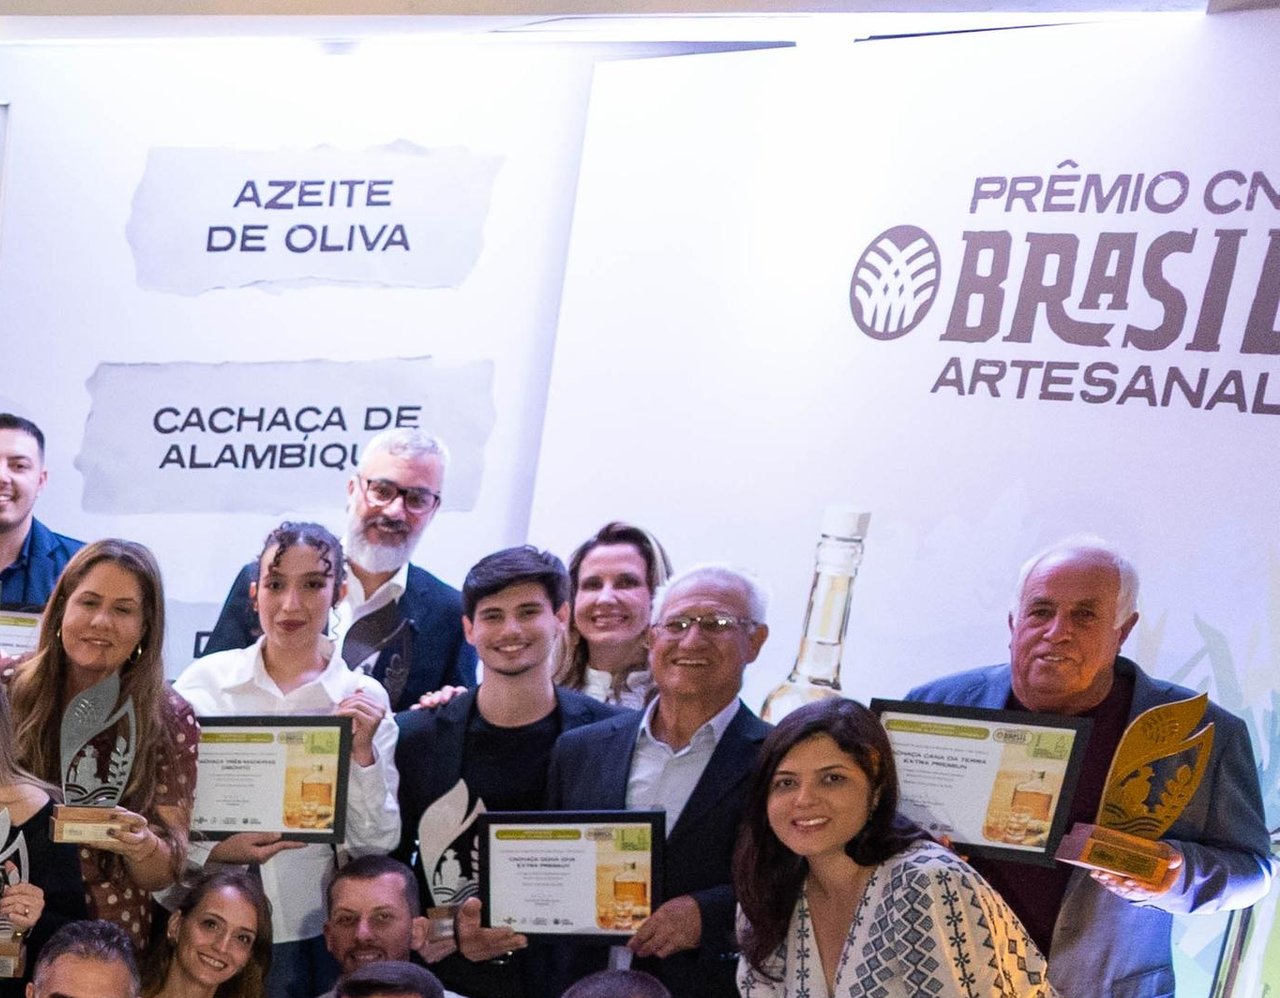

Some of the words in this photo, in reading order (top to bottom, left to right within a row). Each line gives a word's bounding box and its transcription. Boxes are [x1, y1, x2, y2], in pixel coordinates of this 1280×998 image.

[233, 179, 394, 211] AZEITE
[968, 159, 1190, 215] PRÊMIO
[1203, 169, 1280, 215] CN
[206, 225, 268, 253] DE
[284, 224, 411, 253] OLIVA
[930, 357, 1280, 416] ARTESANAL
[152, 406, 347, 441] CACHAÇA
[363, 405, 423, 431] DE
[159, 442, 359, 473] ALAMBIQ
